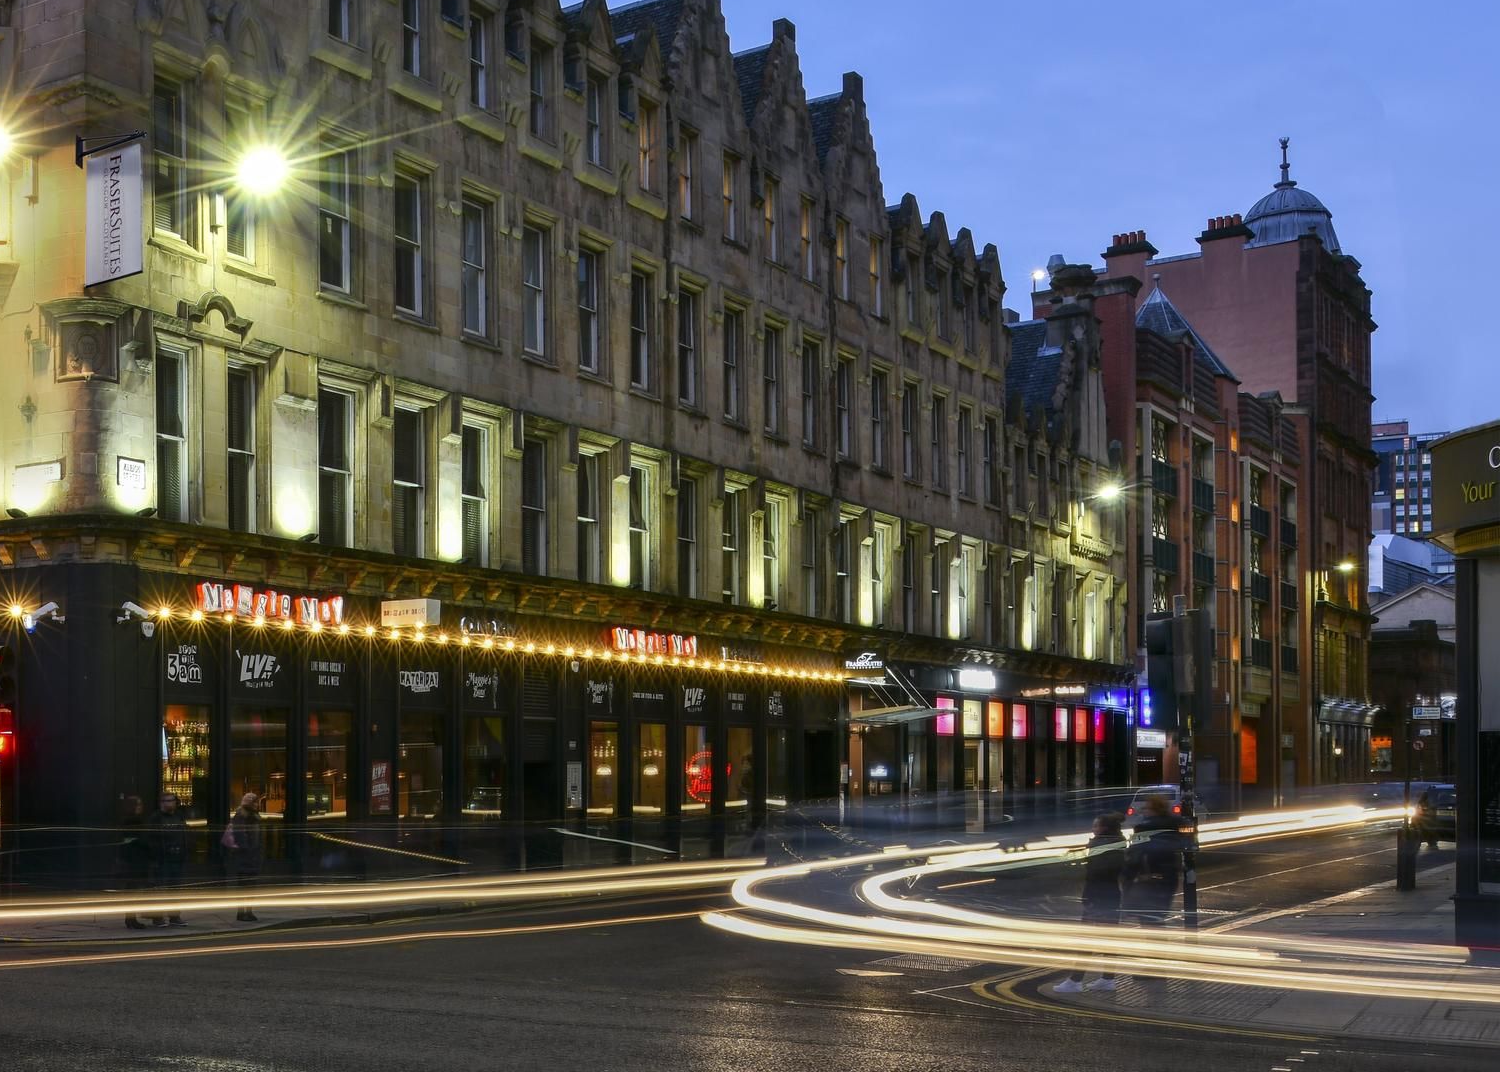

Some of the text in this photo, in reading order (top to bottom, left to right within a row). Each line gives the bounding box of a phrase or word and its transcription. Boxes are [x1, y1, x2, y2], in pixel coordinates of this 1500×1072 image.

[1461, 481, 1495, 504] Your
[197, 582, 344, 625] Maggie May
